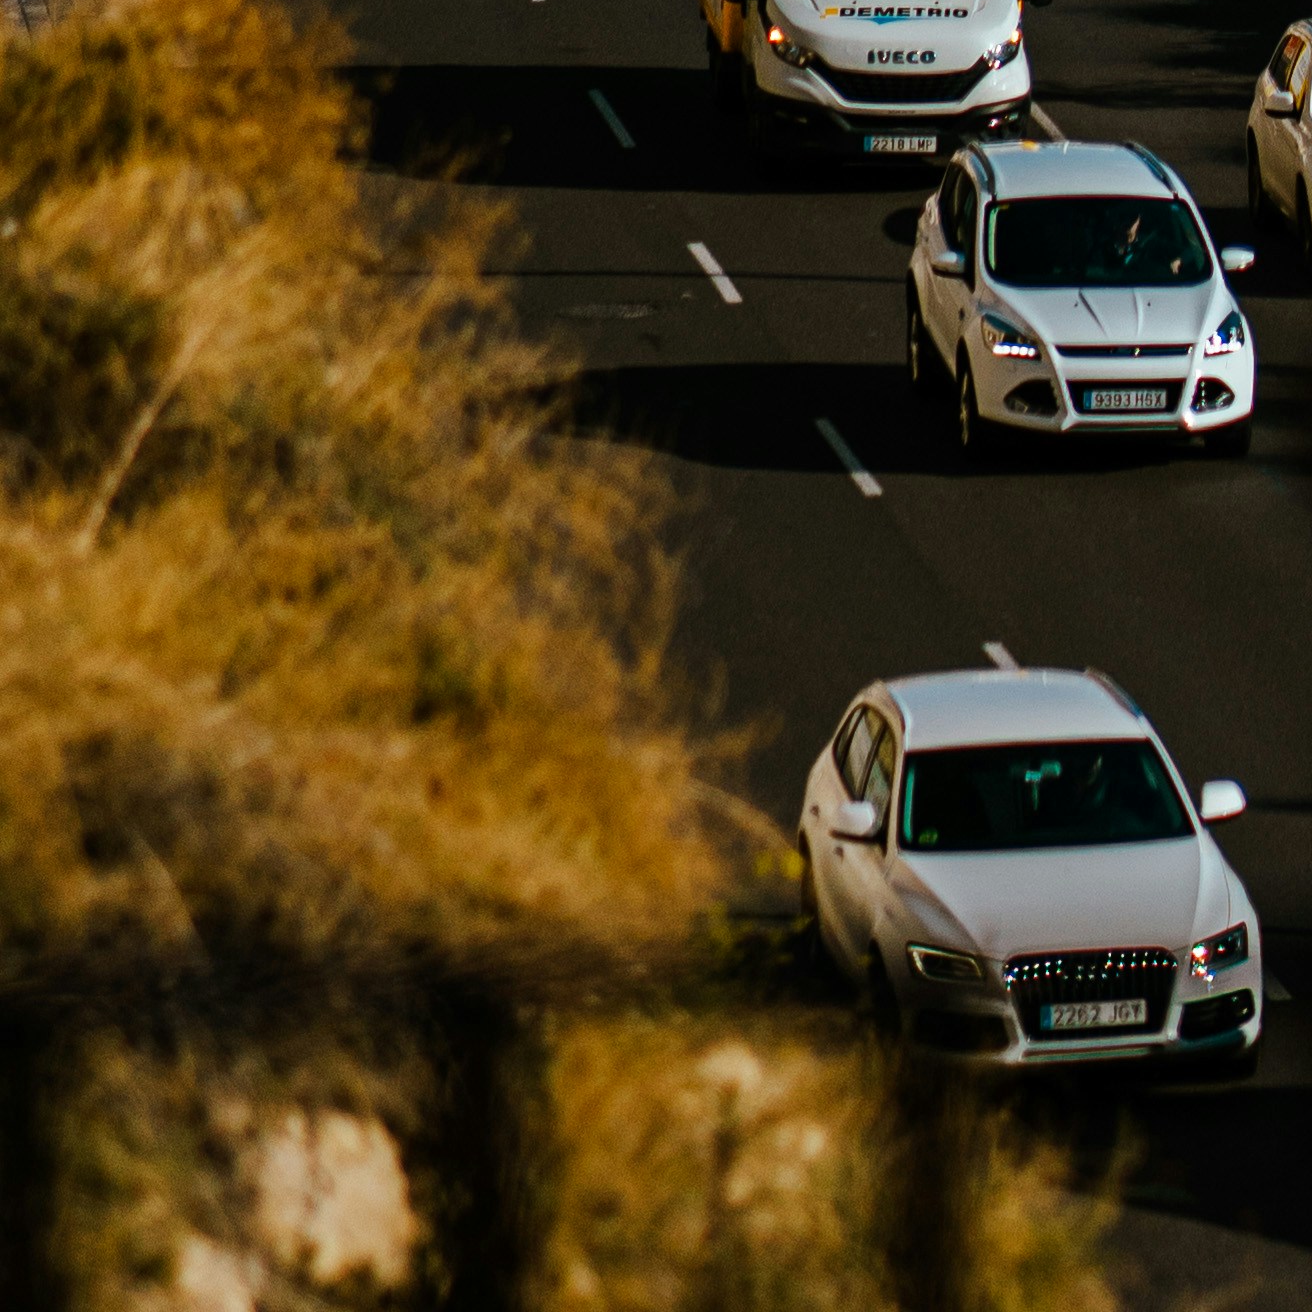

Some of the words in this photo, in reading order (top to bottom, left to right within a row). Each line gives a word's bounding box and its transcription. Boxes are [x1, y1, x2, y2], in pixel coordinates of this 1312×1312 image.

[840, 7, 968, 18] DEMETRIO
[867, 50, 937, 65] IVECO
[909, 138, 933, 151] LMP
[1095, 392, 1131, 407] 9393
